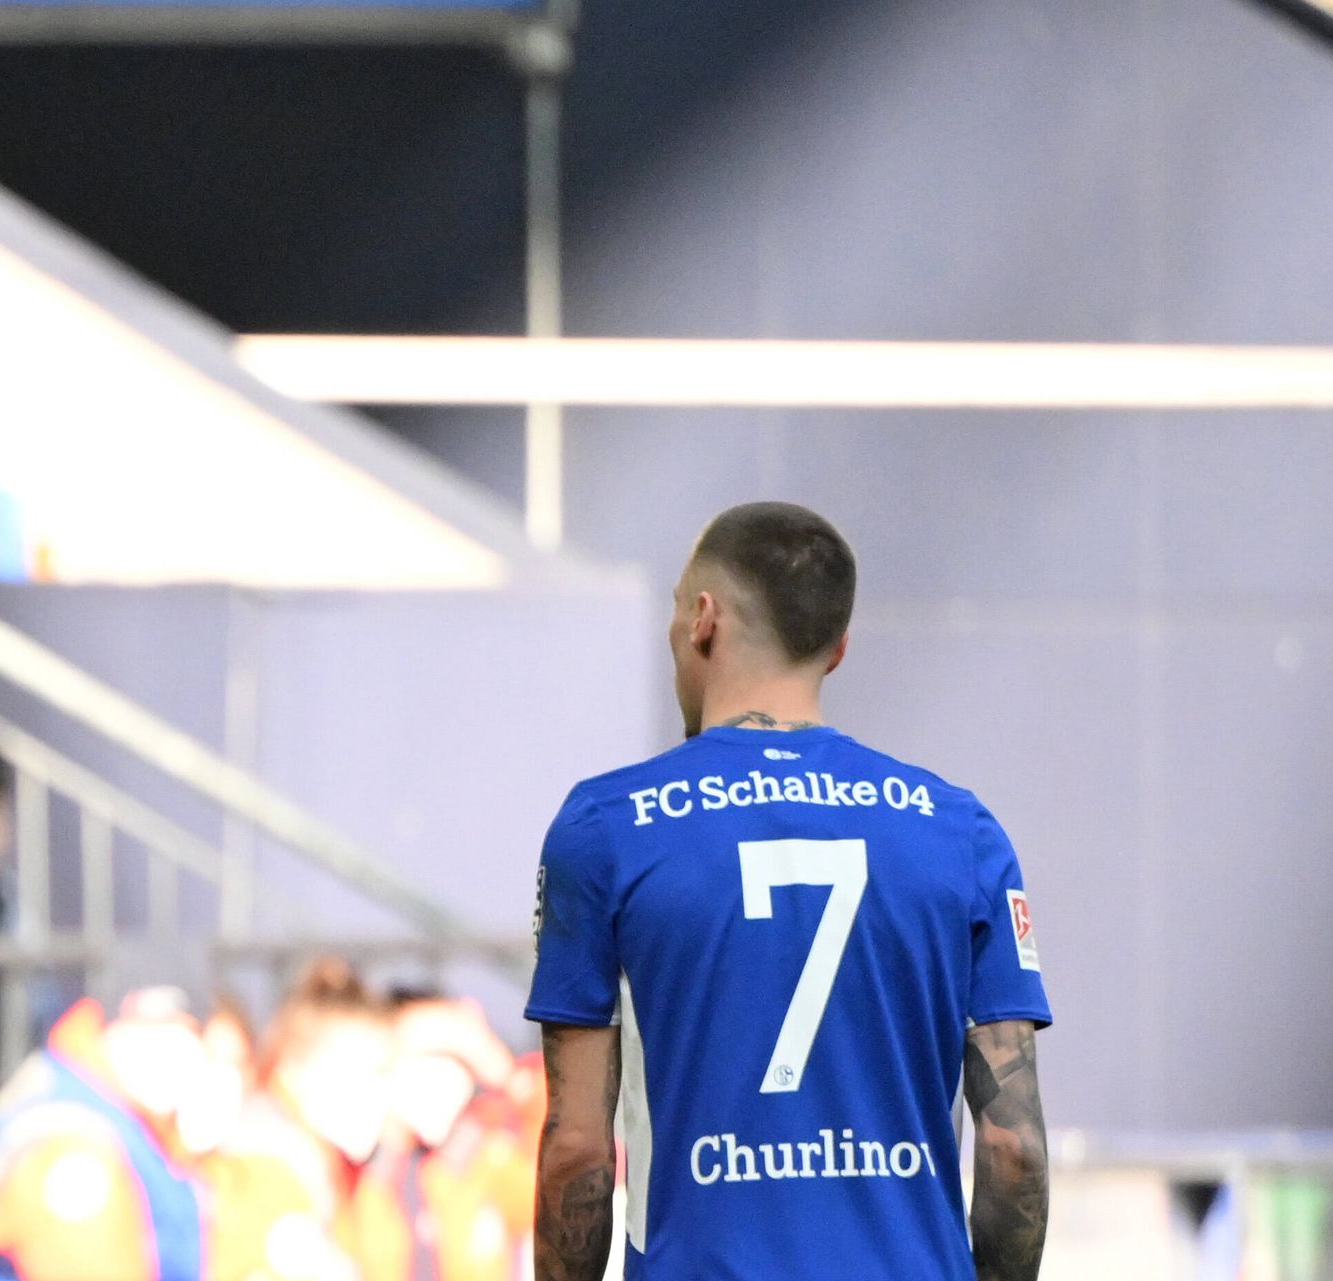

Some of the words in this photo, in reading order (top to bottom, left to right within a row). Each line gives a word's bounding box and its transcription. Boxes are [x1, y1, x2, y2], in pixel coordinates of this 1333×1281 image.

[630, 781, 692, 826] FC
[700, 770, 878, 811] Schalke
[884, 776, 935, 817] 04
[737, 838, 869, 1095] 7
